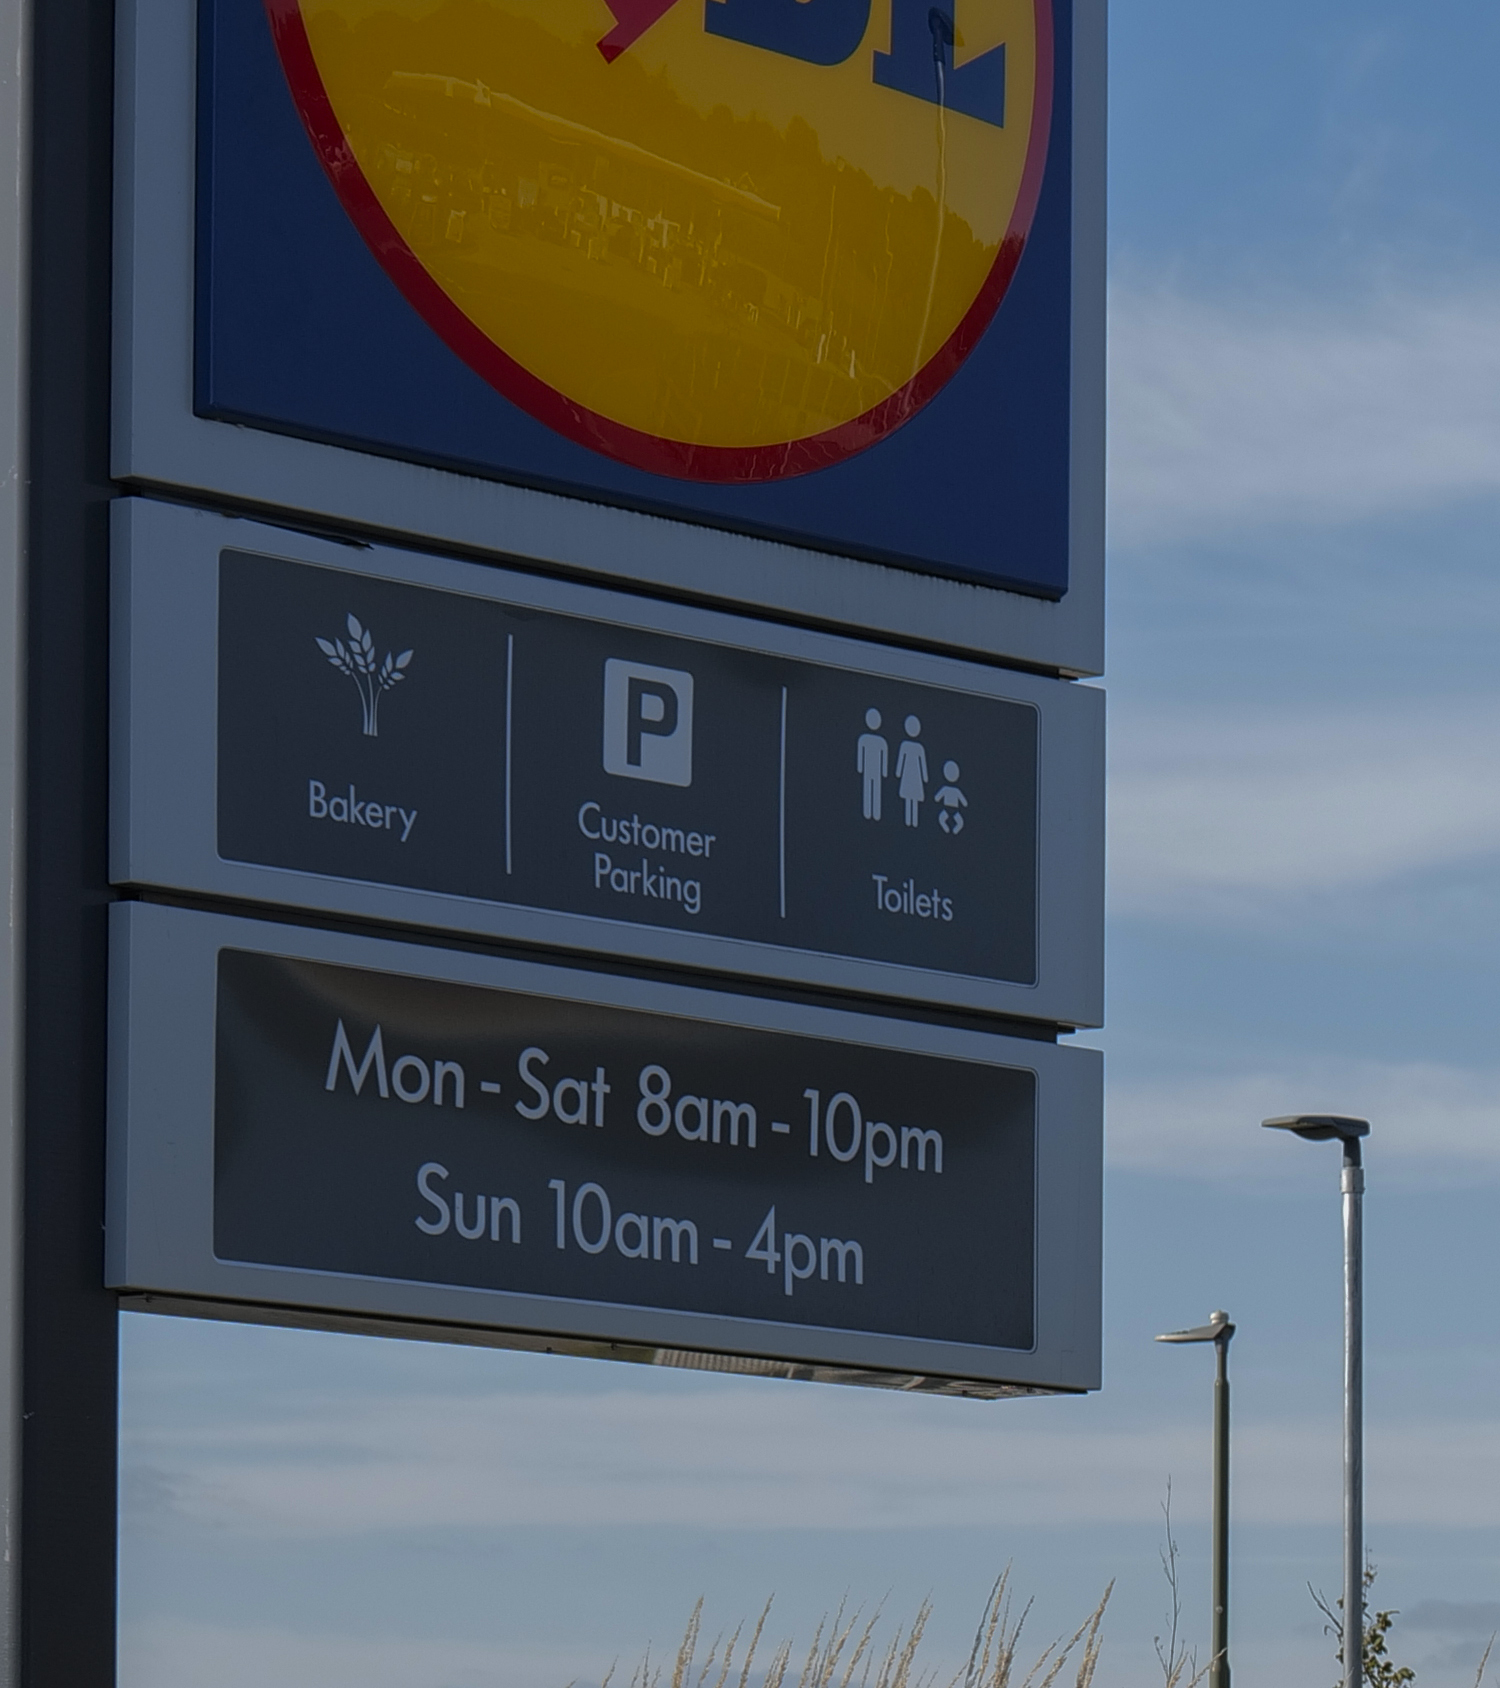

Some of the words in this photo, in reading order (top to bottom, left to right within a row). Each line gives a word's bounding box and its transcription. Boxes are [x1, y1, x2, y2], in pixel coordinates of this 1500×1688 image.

[308, 779, 418, 841] Bakery
[577, 800, 716, 859] Customer
[593, 851, 702, 914] Parking
[873, 874, 954, 923] Toilets
[324, 1018, 465, 1109] Mon
[515, 1046, 611, 1129] Sat
[637, 1063, 757, 1149] 8am
[803, 1089, 944, 1183] 10pm
[414, 1163, 522, 1247] Sun
[548, 1180, 699, 1266] 10am
[745, 1204, 864, 1295] 4pm
